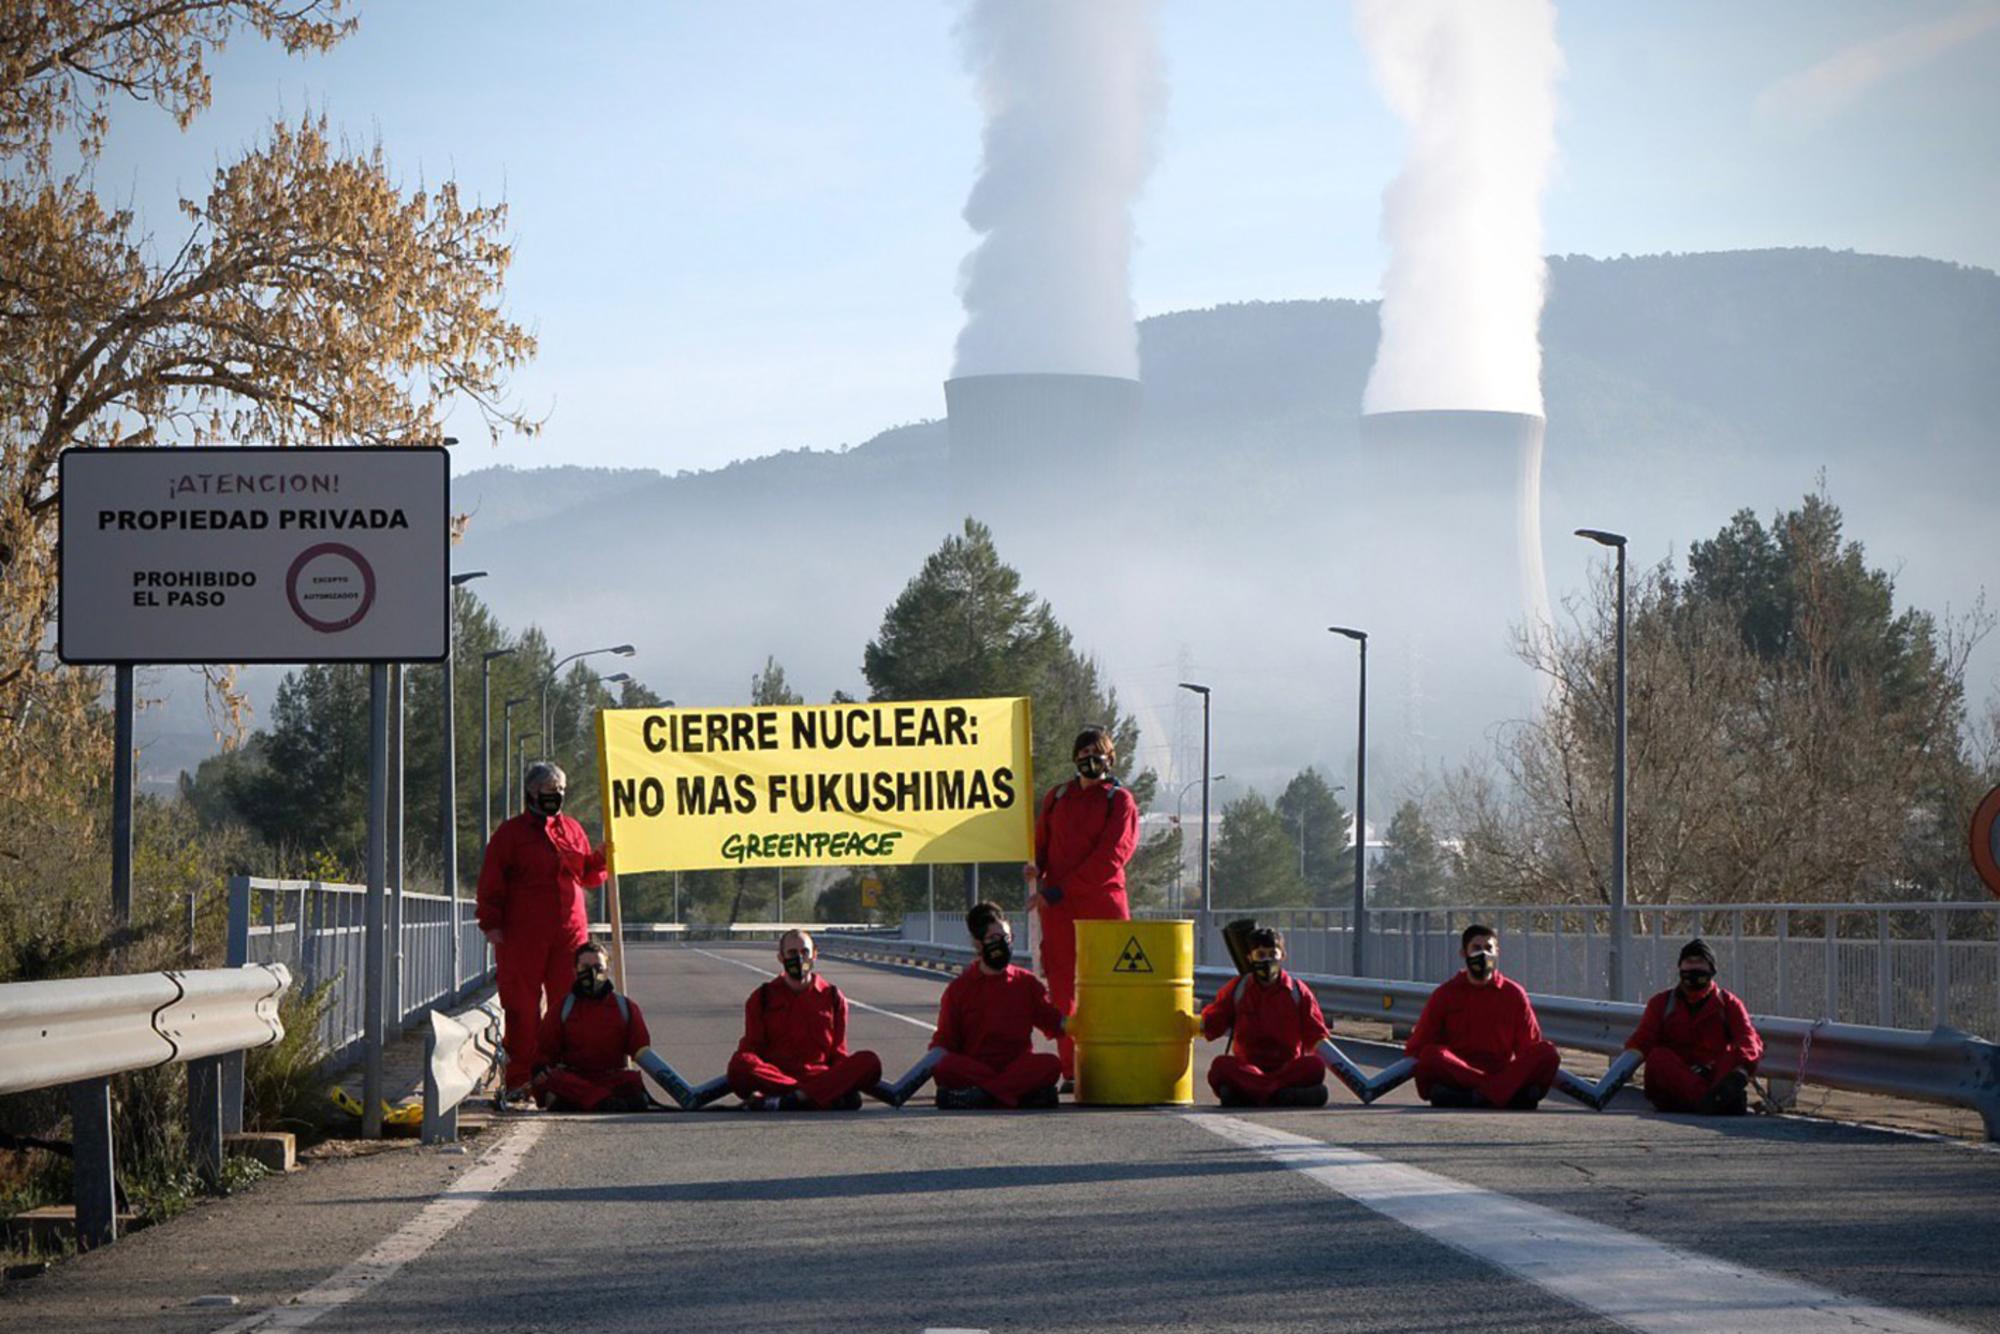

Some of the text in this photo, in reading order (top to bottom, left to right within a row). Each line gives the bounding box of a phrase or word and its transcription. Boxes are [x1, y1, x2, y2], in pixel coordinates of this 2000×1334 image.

[98, 509, 409, 531] PROPIEDAD PRIVADA
[133, 571, 257, 587] PROHIBIDO
[133, 590, 226, 607] EL PASO
[643, 707, 979, 753] CIERRE NUCLEAR:
[612, 767, 1016, 818] NO MAS FUKUSHIMAS
[721, 831, 903, 864] GREENPEACE
